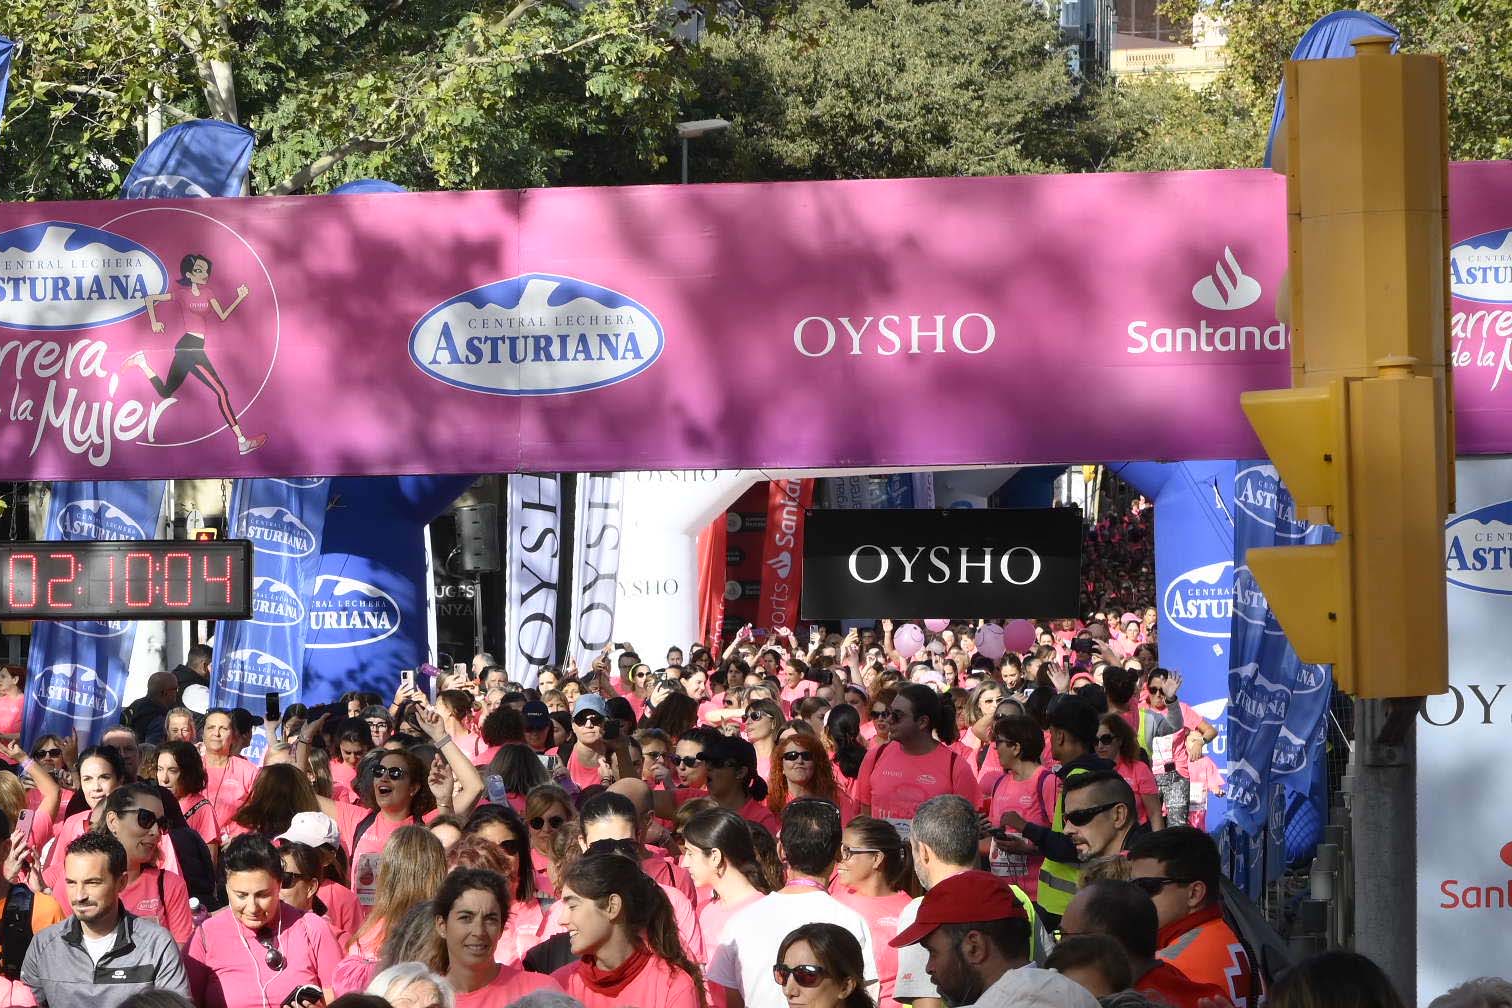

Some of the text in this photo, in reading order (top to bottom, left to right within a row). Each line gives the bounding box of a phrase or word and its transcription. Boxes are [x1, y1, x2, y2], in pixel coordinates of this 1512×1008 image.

[71, 258, 143, 269] LECHERA
[1450, 258, 1512, 286] ASTU
[468, 314, 635, 329] CENTRAL LECHERA
[794, 313, 996, 357] OYSHO
[1127, 320, 1289, 354] Santand
[1451, 311, 1512, 338] arre
[429, 321, 643, 366] ASTURIANA
[1477, 341, 1494, 367] la
[10, 379, 33, 421] la
[29, 373, 179, 466] Mujer
[518, 473, 559, 665] OYSH
[579, 473, 620, 650] OYSH
[849, 545, 1041, 584] OYSHO
[1446, 535, 1512, 572] AST
[8, 553, 231, 608] 02:10:04
[618, 579, 679, 596] YSHO
[1188, 588, 1233, 596] CENTRA
[253, 597, 297, 620] URIANA
[310, 610, 391, 630] URIANA
[1171, 590, 1233, 619] ASTU
[1420, 684, 1512, 726] OY
